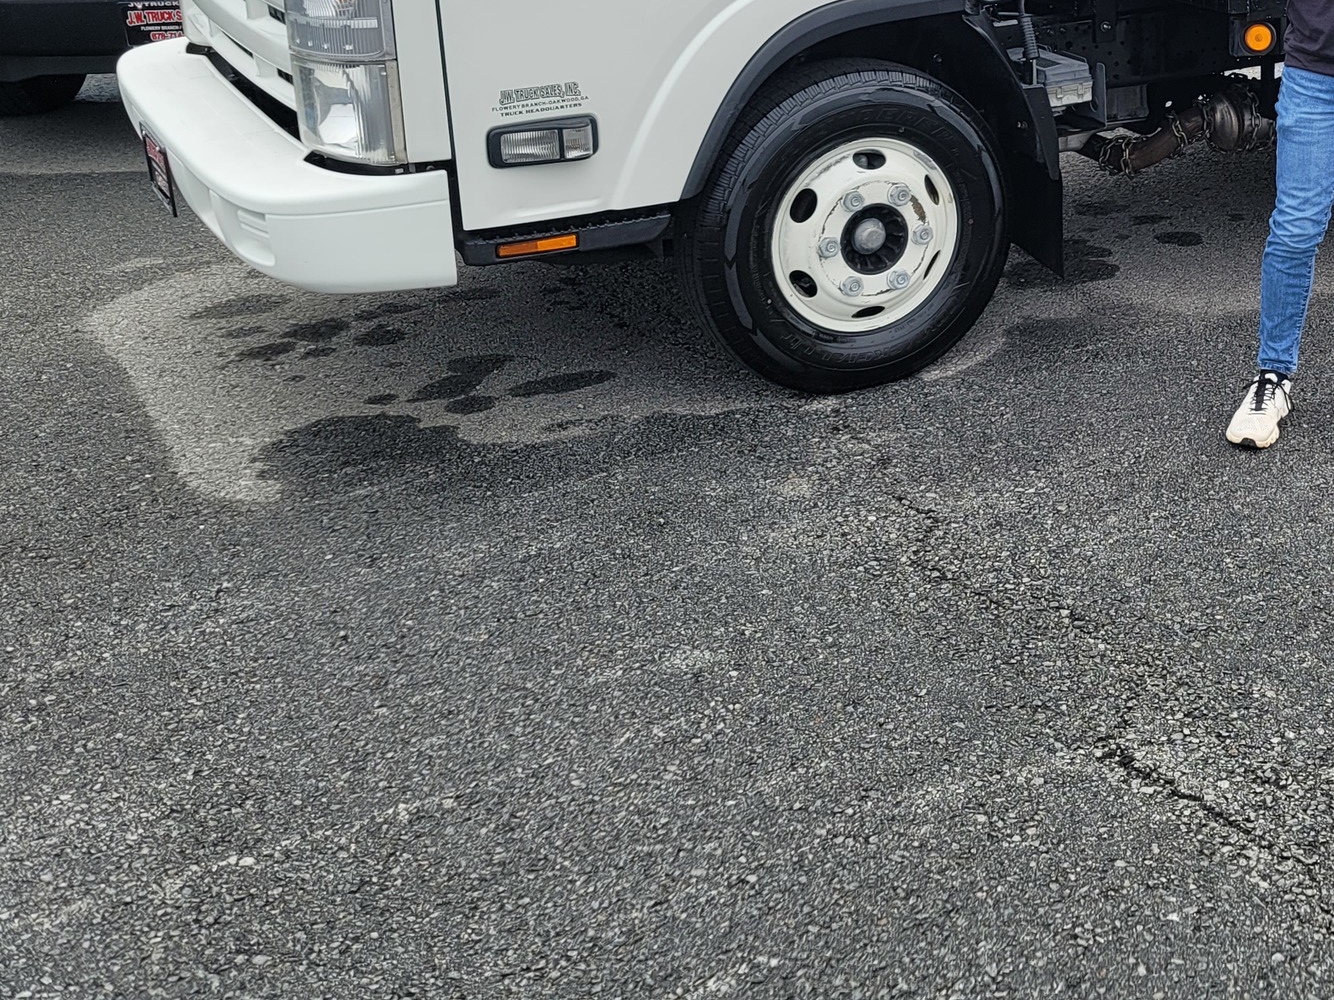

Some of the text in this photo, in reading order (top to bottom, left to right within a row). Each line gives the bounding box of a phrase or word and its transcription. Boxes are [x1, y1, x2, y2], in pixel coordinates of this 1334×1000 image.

[144, 10, 175, 24] TRUCK
[514, 86, 541, 102] TRUCK
[492, 104, 521, 112] FLOWERY
[525, 102, 582, 114] HEADQUARTERS
